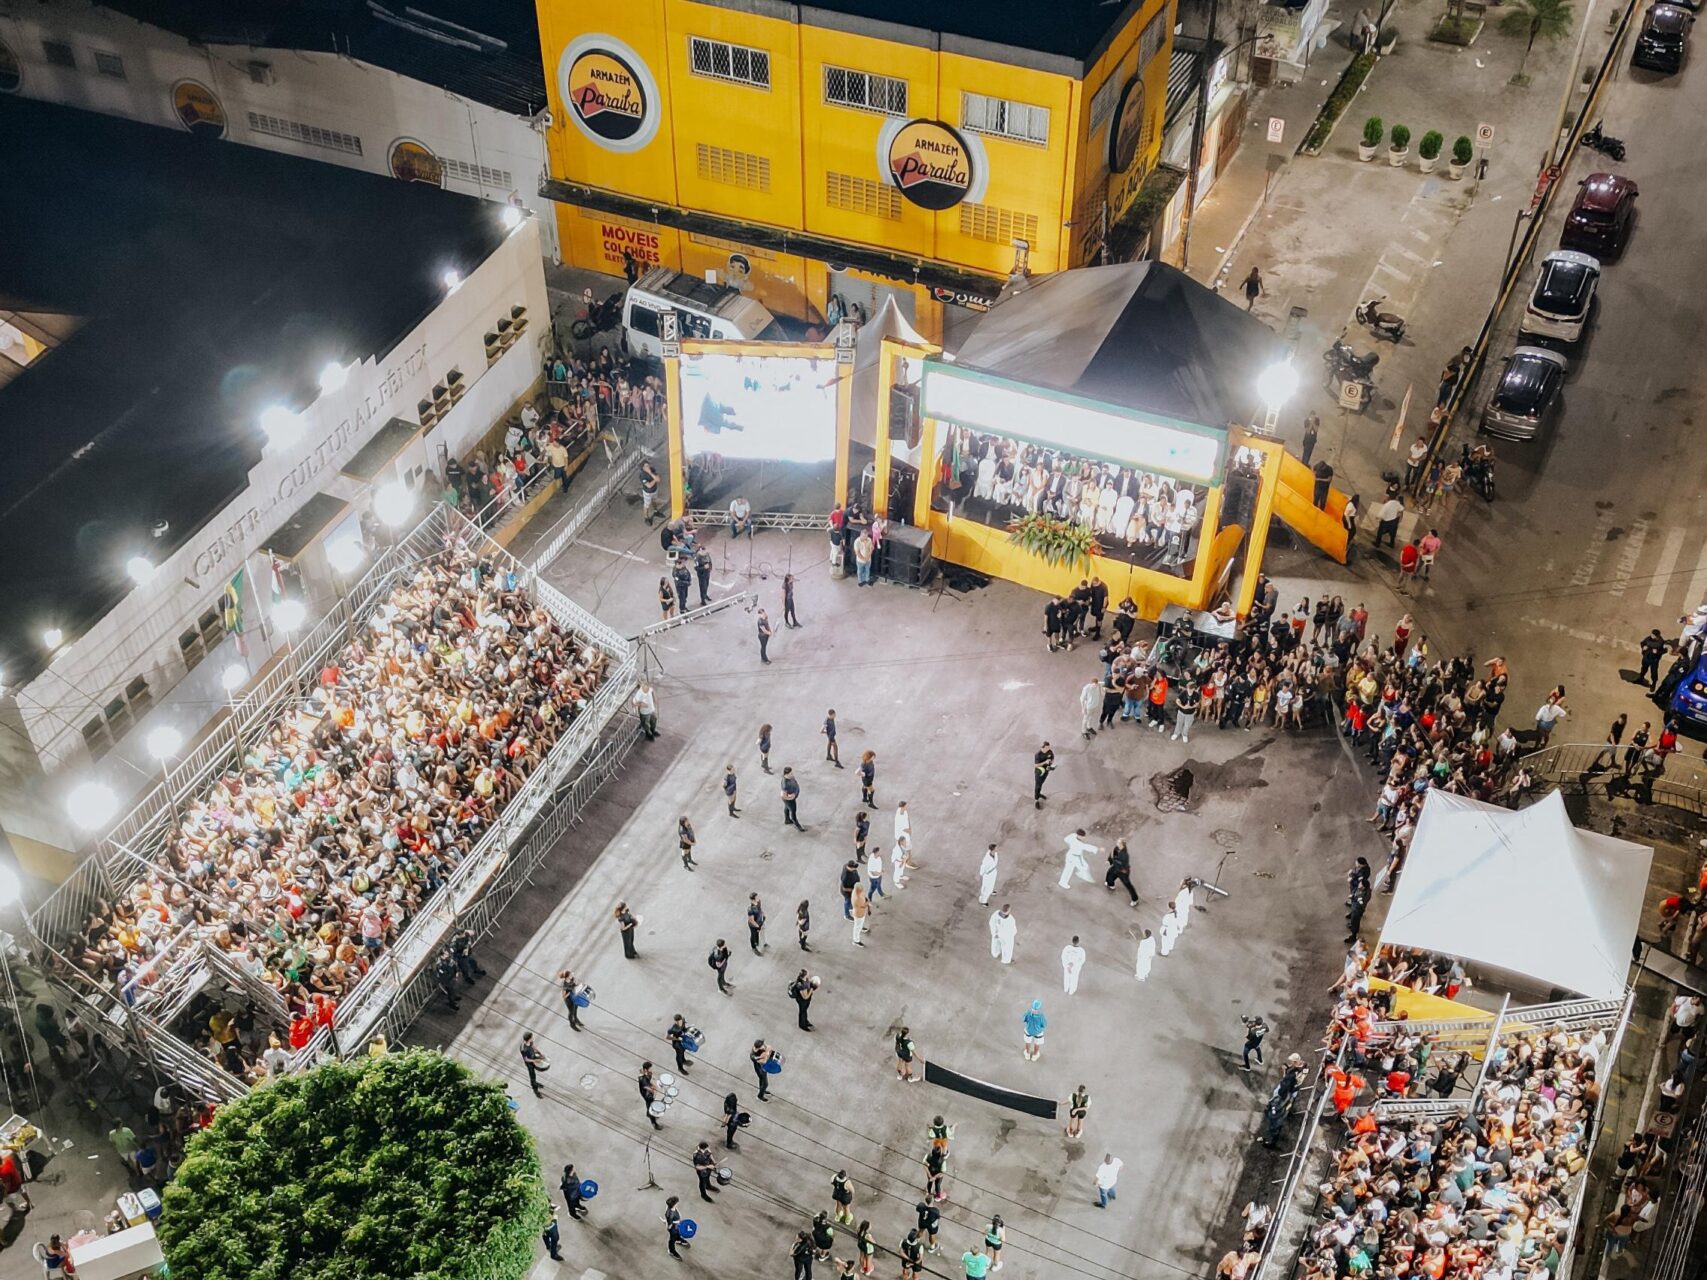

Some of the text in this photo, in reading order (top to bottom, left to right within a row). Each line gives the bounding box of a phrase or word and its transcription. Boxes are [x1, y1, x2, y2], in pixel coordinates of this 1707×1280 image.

[915, 138, 958, 156] ARMAZÉM
[603, 240, 660, 262] COLCHÕES
[278, 397, 376, 500] CULTURAL
